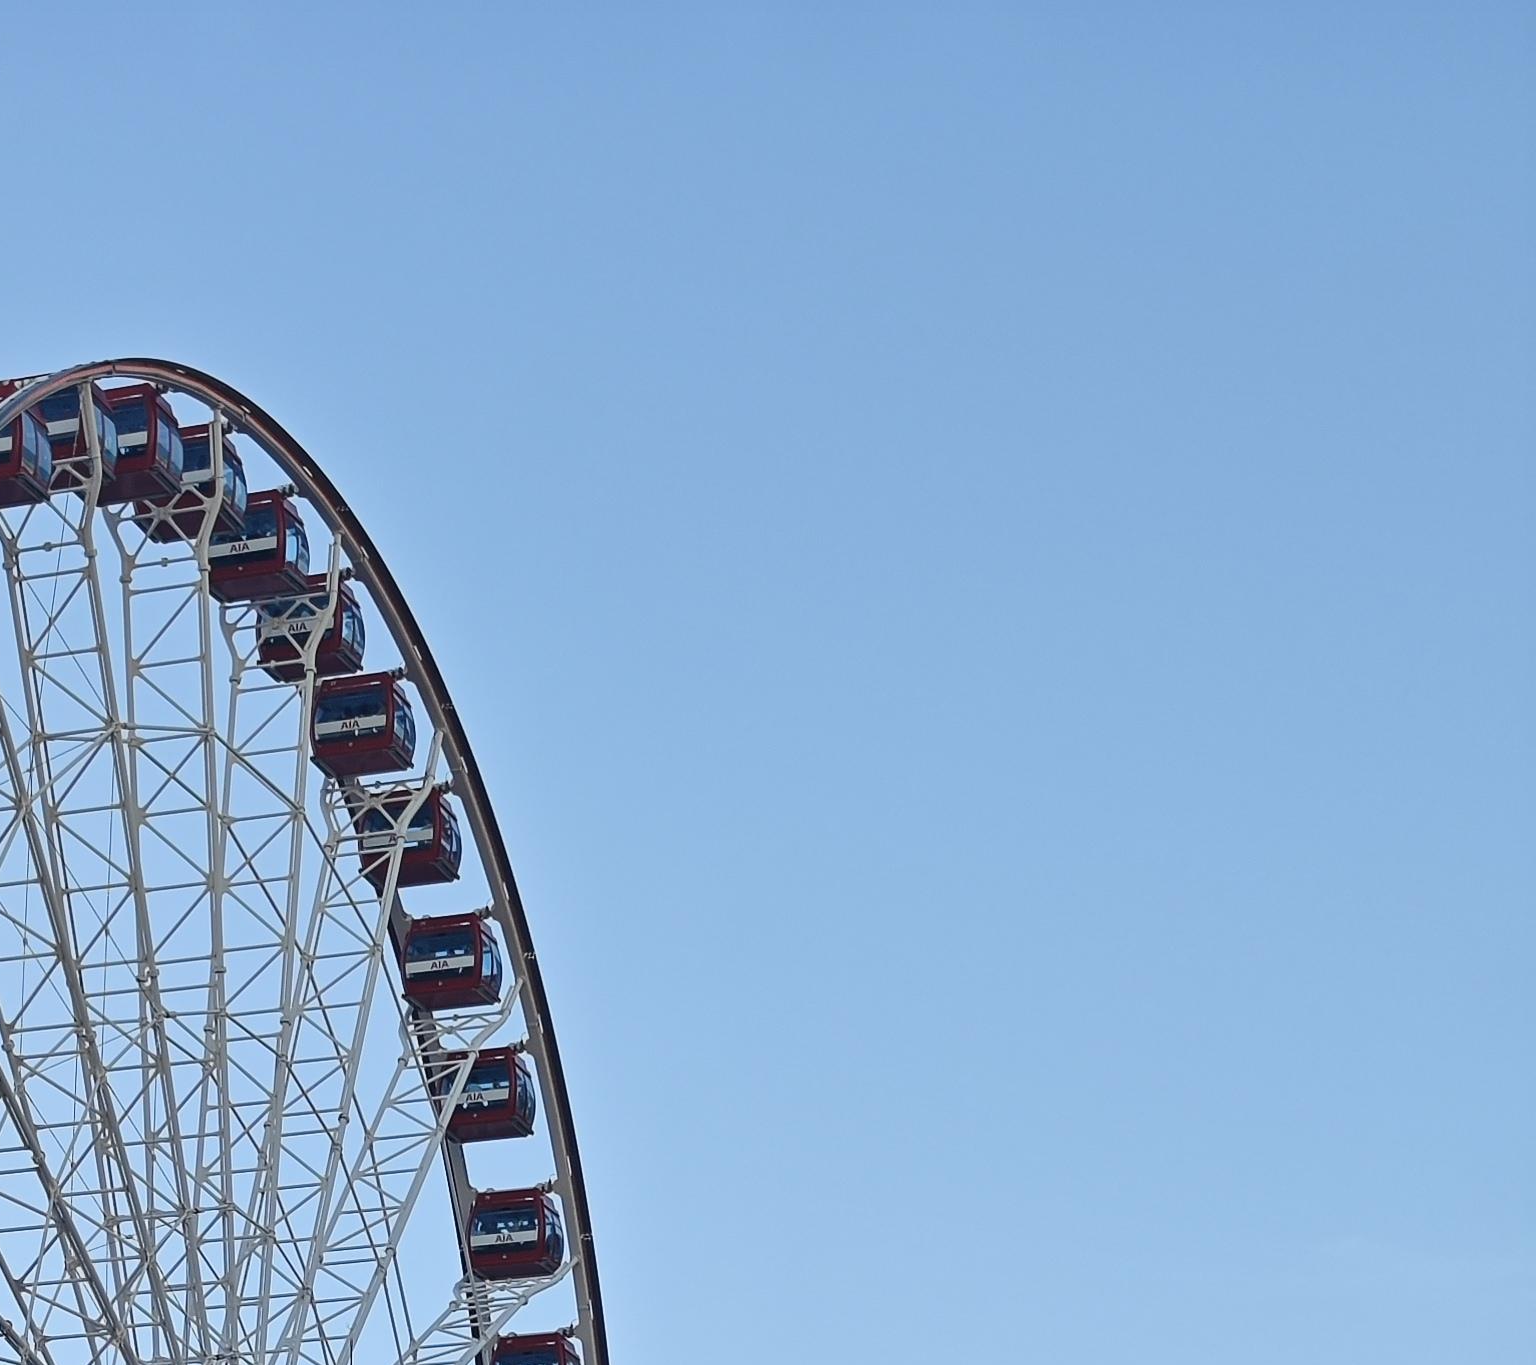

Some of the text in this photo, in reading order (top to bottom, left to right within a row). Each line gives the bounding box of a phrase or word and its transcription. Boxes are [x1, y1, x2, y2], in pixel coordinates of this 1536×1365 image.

[229, 542, 250, 553] AIA
[288, 622, 307, 633] AIA
[341, 719, 360, 730] AIA
[430, 960, 450, 970] AIA
[466, 1091, 485, 1102] AIA
[495, 1233, 514, 1243] AIA
